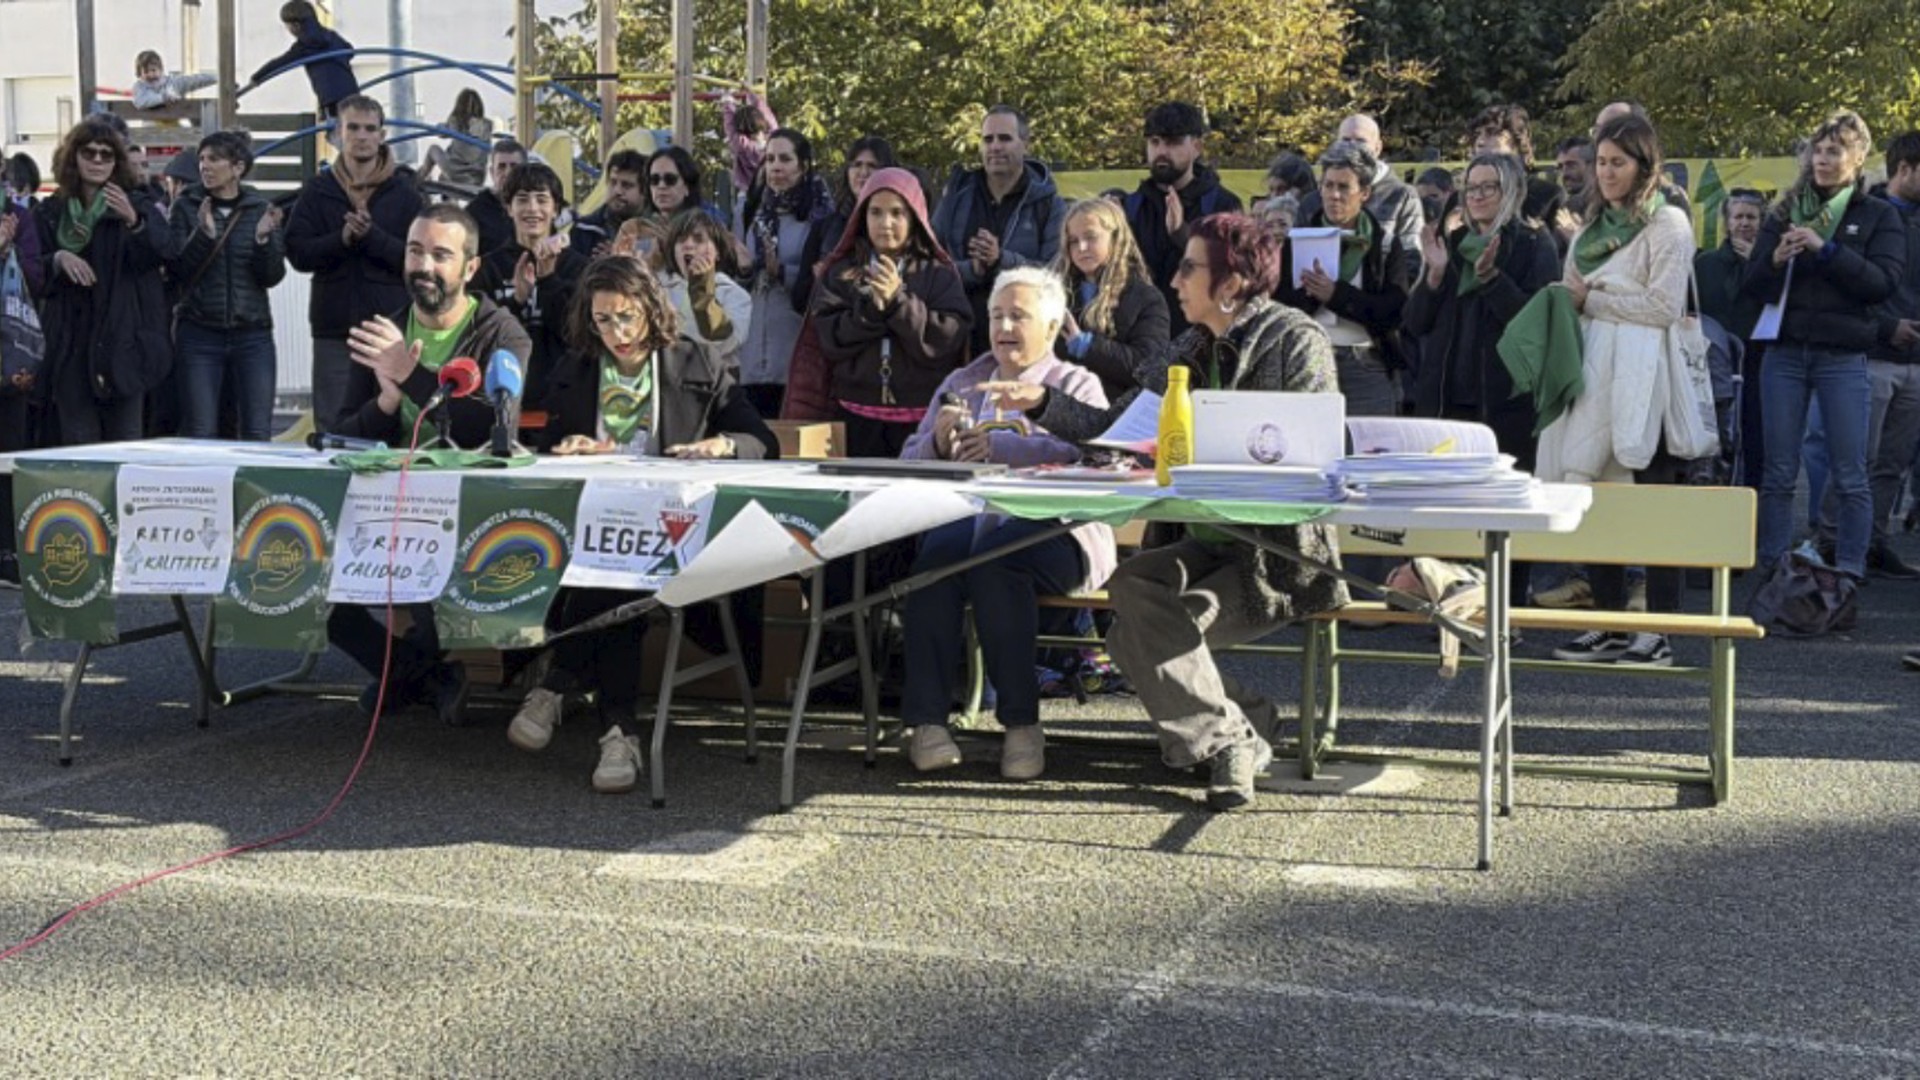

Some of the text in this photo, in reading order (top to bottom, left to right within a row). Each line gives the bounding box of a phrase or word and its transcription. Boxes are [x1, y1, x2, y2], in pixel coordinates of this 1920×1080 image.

[136, 525, 196, 543] RATIO
[583, 524, 670, 557] LEGEZ
[372, 535, 439, 554] RATIO
[144, 554, 220, 571] KALITATEA
[342, 561, 413, 579] CALIDAD
